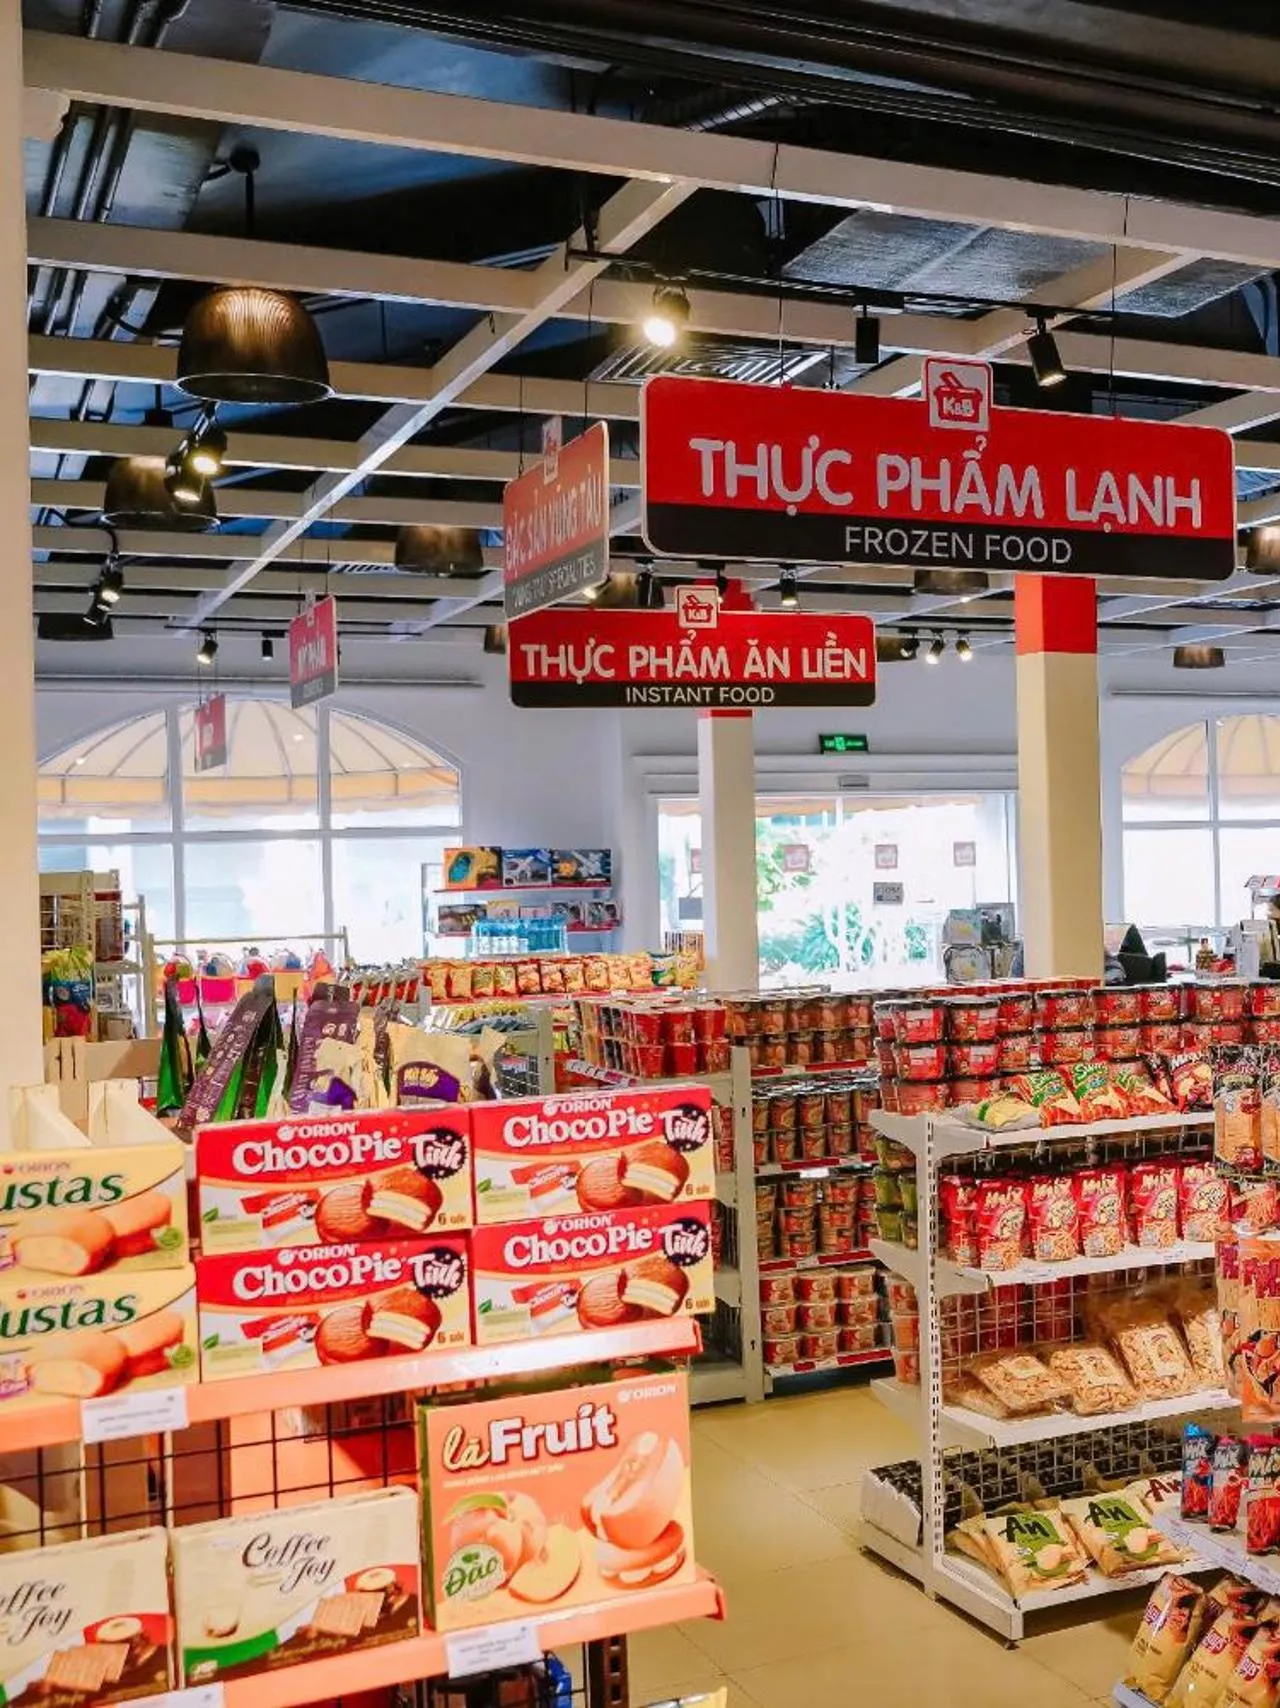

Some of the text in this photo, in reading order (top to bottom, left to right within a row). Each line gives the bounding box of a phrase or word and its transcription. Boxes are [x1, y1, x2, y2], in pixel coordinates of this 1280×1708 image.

[688, 434, 1202, 533] THỰC PHẨM LẠNH
[845, 526, 1073, 564] FROZEN FOOD
[520, 629, 867, 685] THỰC PHẨM ĂN LIỀN
[626, 686, 776, 704] INSTANT FOOD
[558, 1097, 613, 1113] ORION
[300, 1121, 357, 1138] ORION
[558, 1214, 613, 1231] ORION
[300, 1244, 357, 1260] ORION
[632, 1384, 677, 1400] ORION
[241, 1532, 331, 1569] Coffee
[279, 1556, 336, 1593] Joy
[444, 1556, 499, 1598] Đào
